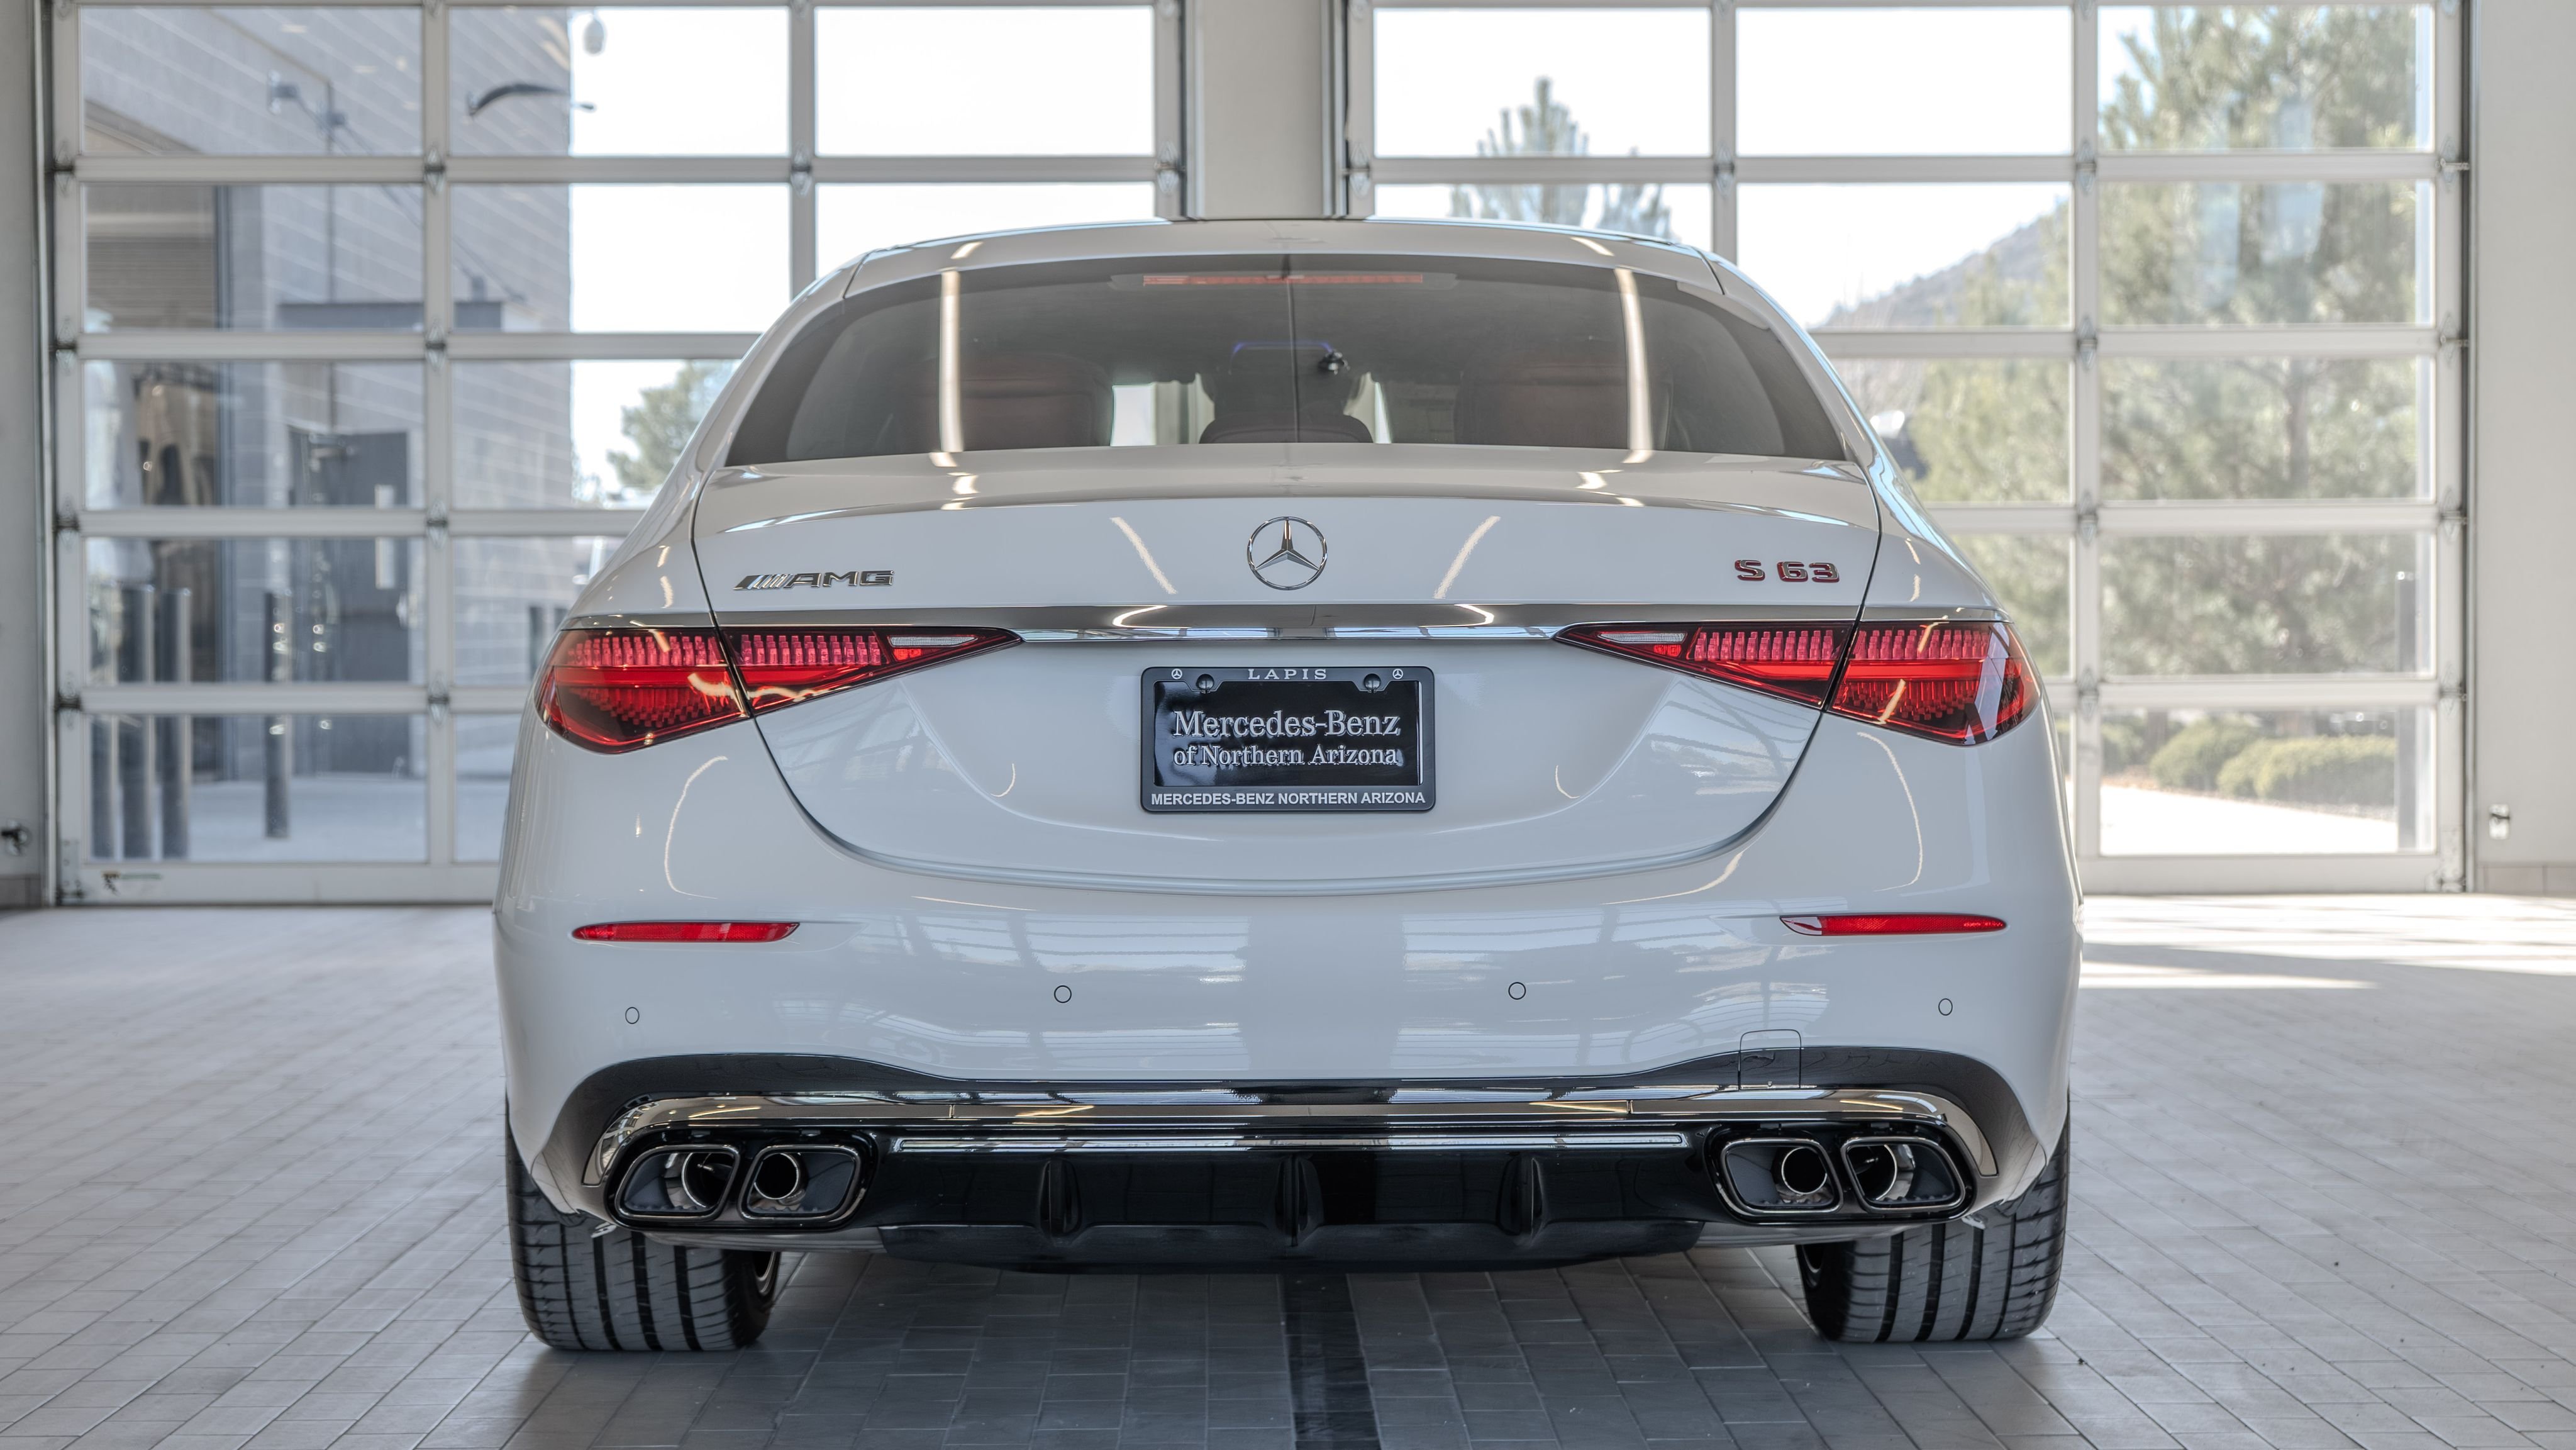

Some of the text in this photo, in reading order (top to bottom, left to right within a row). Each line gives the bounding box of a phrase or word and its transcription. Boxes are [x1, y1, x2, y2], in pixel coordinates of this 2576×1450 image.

[1735, 560, 1840, 583] S 63
[1248, 669, 1327, 680] LAPIS
[1172, 710, 1401, 737] Mercedes-Benz
[1173, 744, 1398, 766] of Northern Arizona
[1151, 793, 1426, 805] MERCEDES-BENZ NORTHERN ARIZONA
